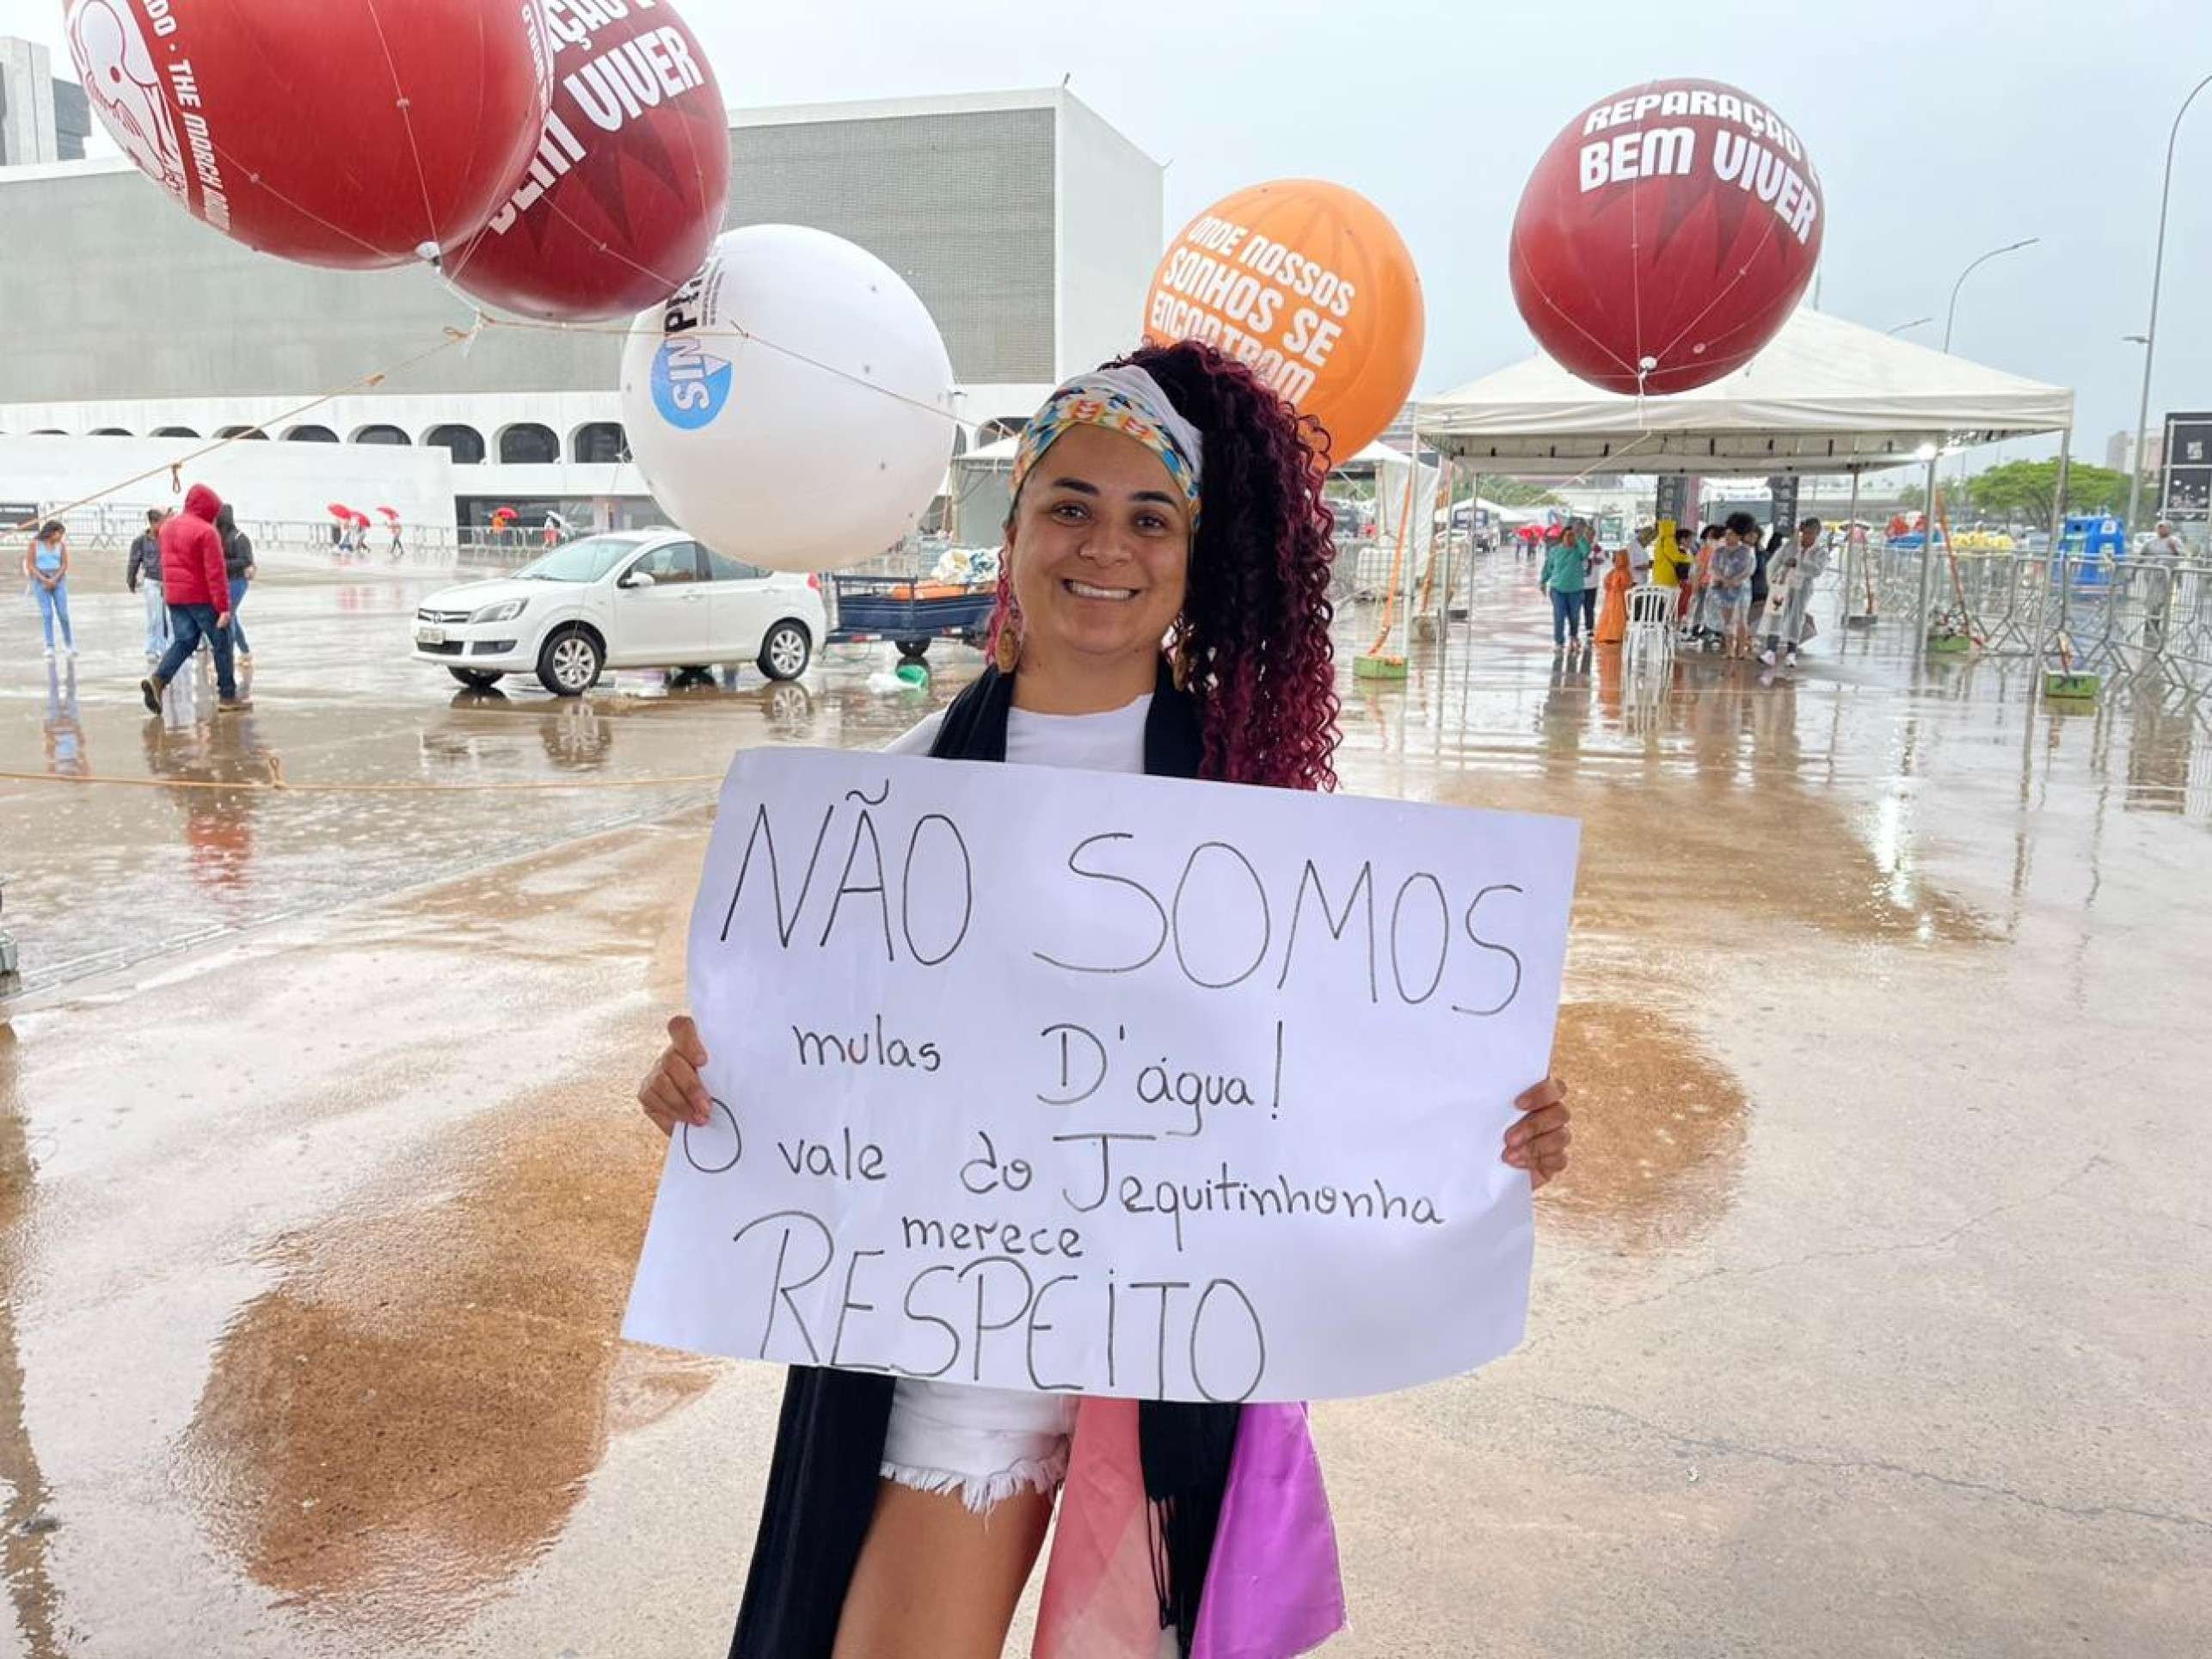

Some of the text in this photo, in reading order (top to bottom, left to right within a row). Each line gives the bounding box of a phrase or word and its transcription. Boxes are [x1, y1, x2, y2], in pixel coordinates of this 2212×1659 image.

[167, 58, 202, 108] THE
[183, 112, 224, 191] MARCH
[1579, 126, 1696, 194] BEM
[1163, 246, 1343, 368] SONHOS SE
[1238, 234, 1356, 318] NOSSOS
[720, 777, 1524, 1015] NÃO SOMOS
[791, 1013, 942, 1072] mulas
[684, 1097, 1445, 1252] O vale do Jequitinhonha
[902, 1215, 1084, 1258] merece
